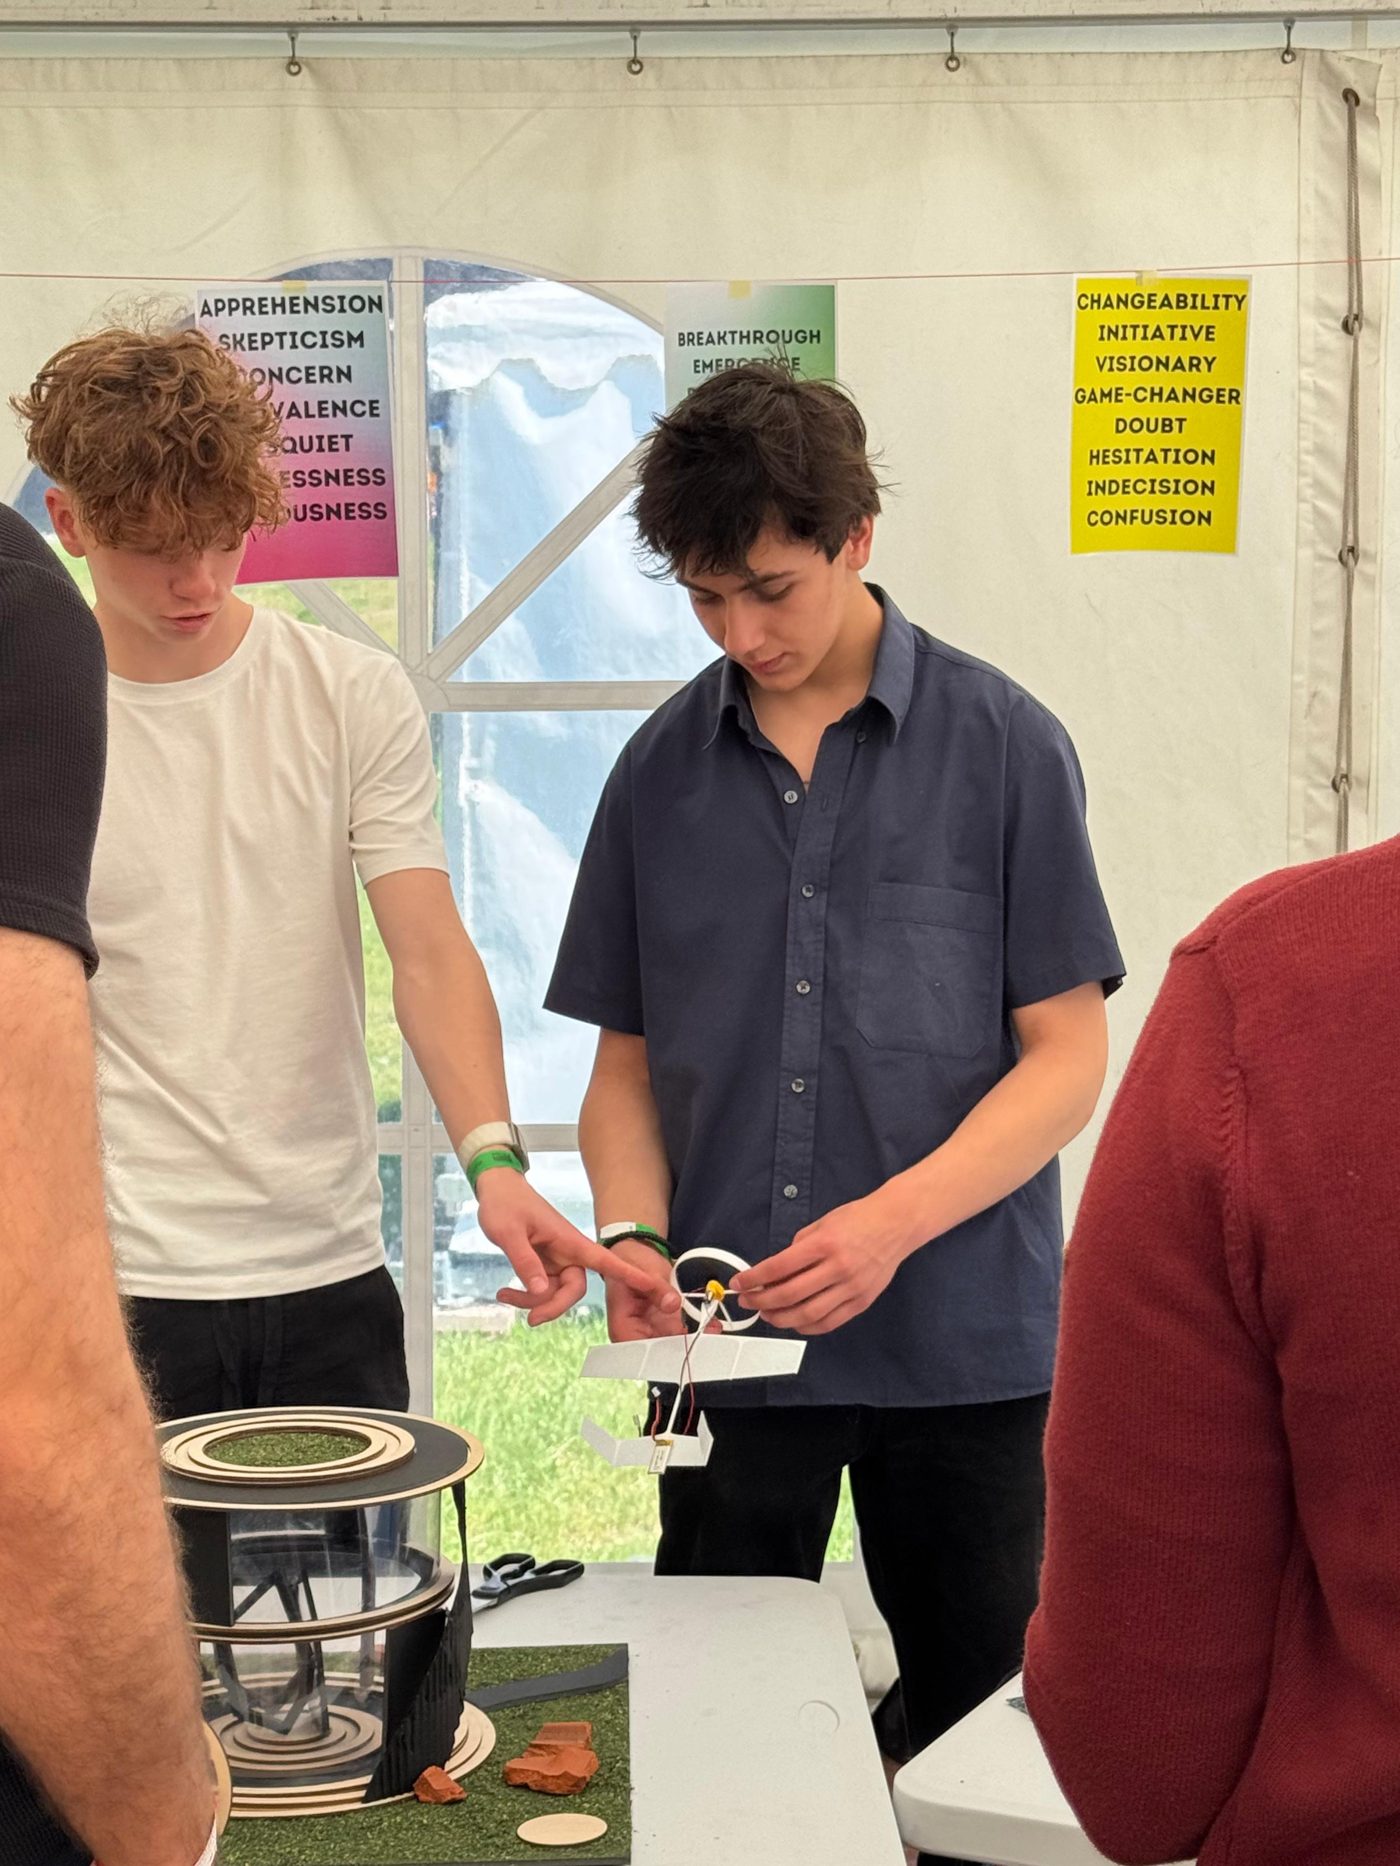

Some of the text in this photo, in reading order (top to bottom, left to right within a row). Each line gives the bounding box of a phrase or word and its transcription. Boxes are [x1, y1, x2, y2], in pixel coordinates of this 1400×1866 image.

[200, 294, 384, 318] APPREHENSION
[1077, 293, 1247, 311] CHANGEABILITY
[219, 330, 365, 352] SKEPTICISM
[677, 329, 821, 347] BREAKTHROUGH
[1098, 324, 1216, 342] INITIATIVE
[1096, 356, 1217, 373] VISIONARY
[1074, 387, 1241, 405] GAME-CHANGER
[270, 399, 381, 420] VALENCE
[1114, 417, 1187, 434] DOUBT
[281, 434, 354, 455] QUIET
[1089, 448, 1216, 466] HESITATION
[1086, 478, 1216, 497] INDECISION
[1087, 509, 1212, 527] CONFUSION
